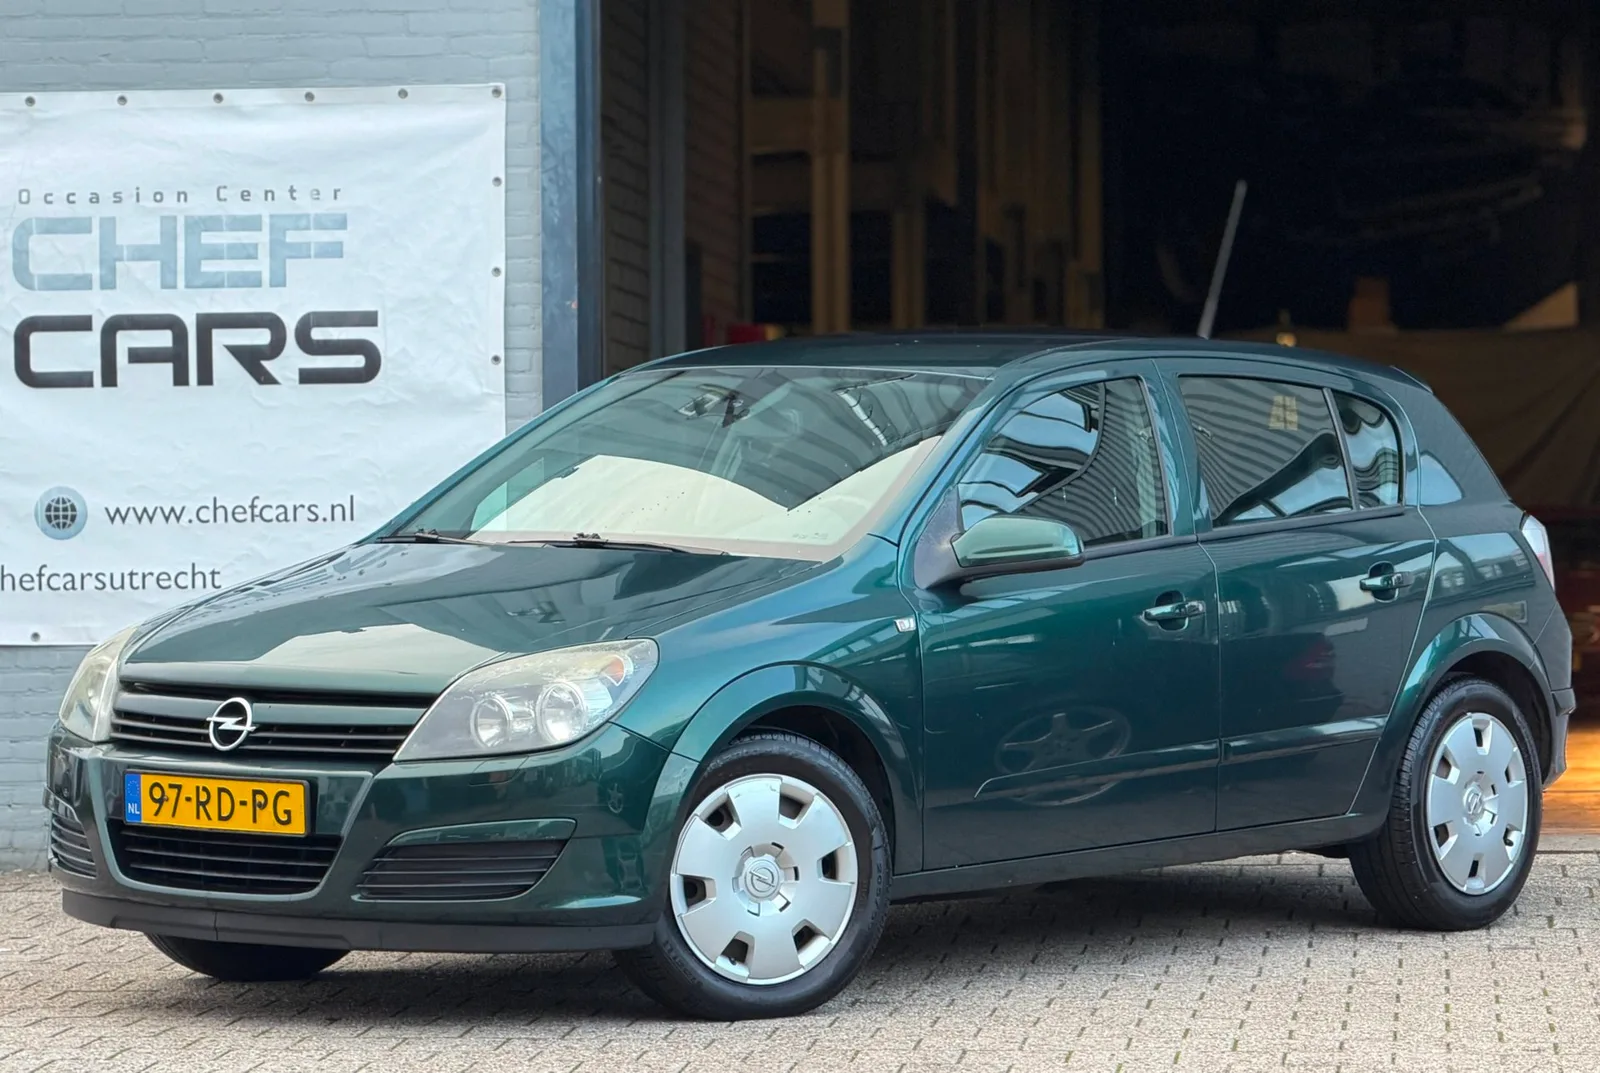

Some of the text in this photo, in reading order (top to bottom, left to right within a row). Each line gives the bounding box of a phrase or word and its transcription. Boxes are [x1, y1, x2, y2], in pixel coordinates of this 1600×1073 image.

[18, 185, 342, 205] Occasion Center
[12, 213, 348, 291] CHEF
[14, 310, 382, 388] CARS
[104, 495, 355, 525] www.chefcars.nl
[128, 803, 140, 815] NL
[149, 781, 292, 826] 97-RD-PG
